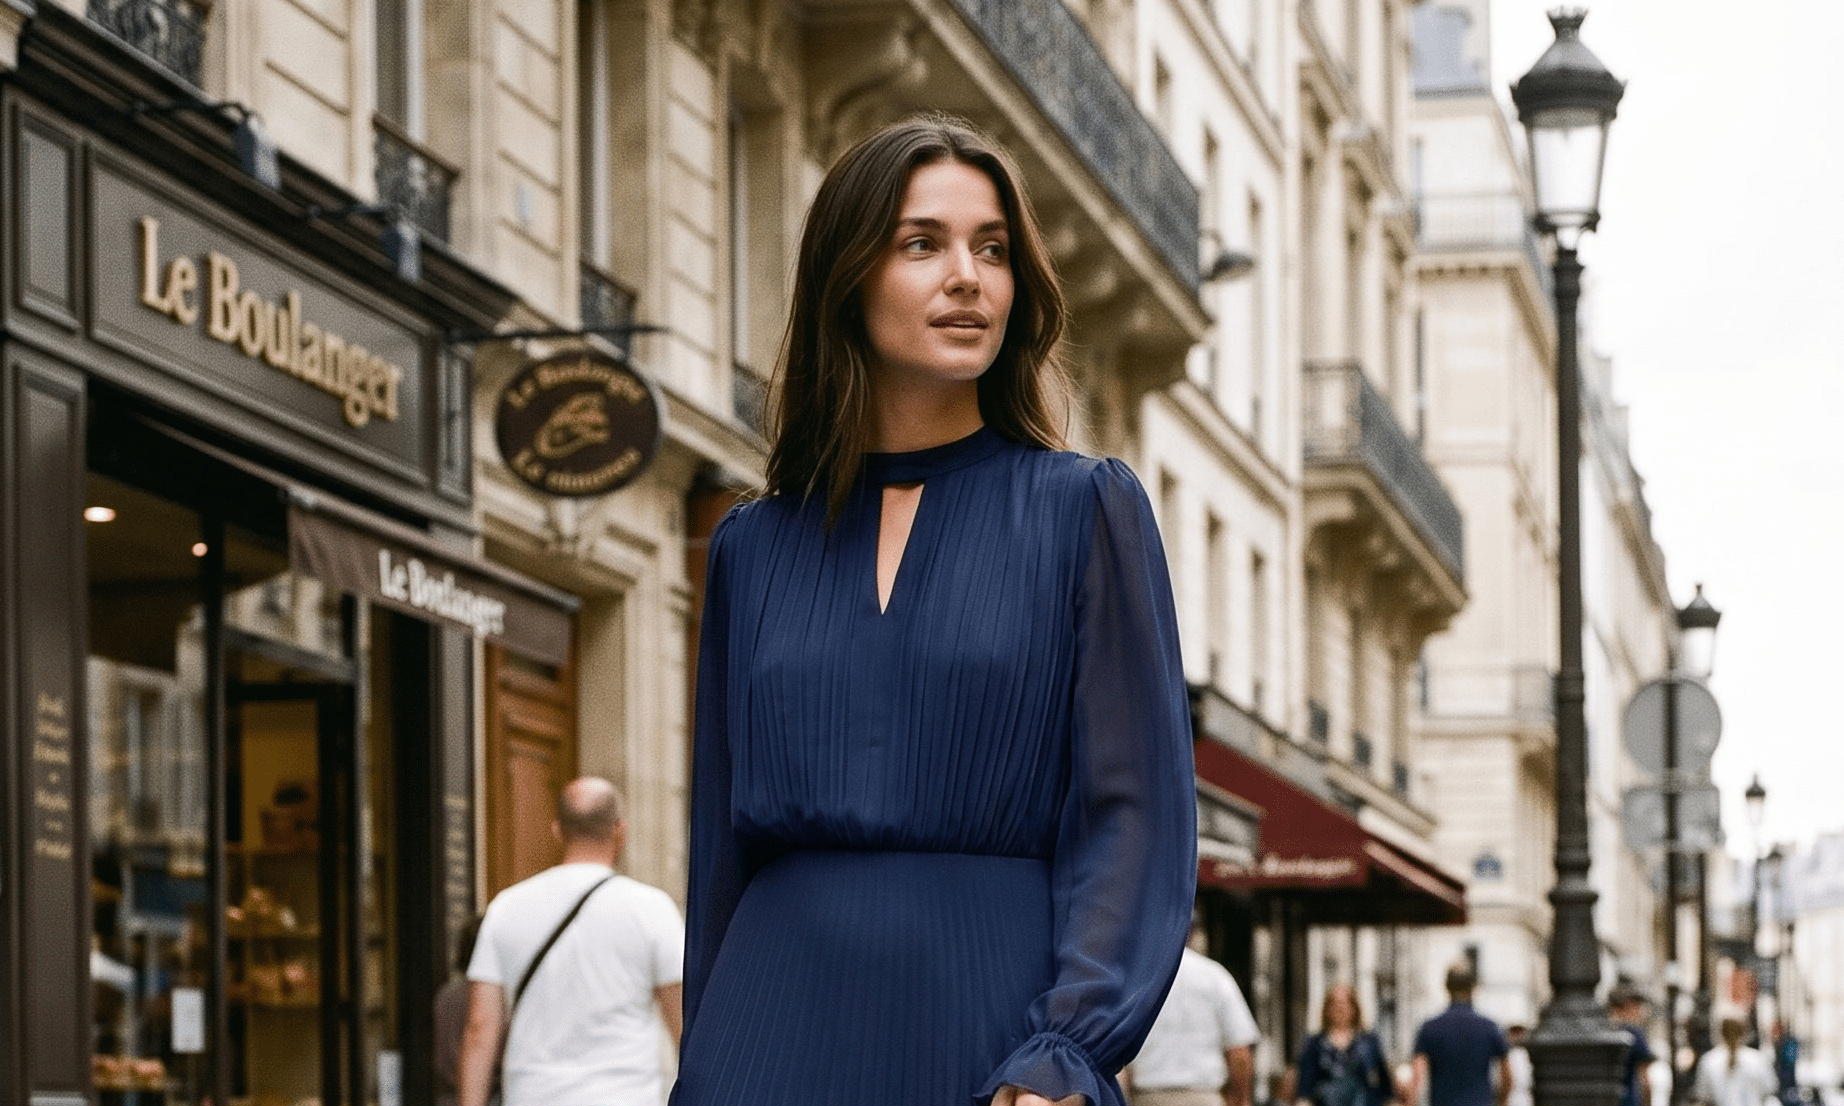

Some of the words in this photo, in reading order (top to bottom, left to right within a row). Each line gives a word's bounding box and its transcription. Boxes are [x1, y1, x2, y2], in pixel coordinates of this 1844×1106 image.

[141, 214, 198, 326] Le
[207, 250, 402, 428] Boulanger
[378, 547, 408, 602] Le
[407, 558, 506, 636] Boulanger
